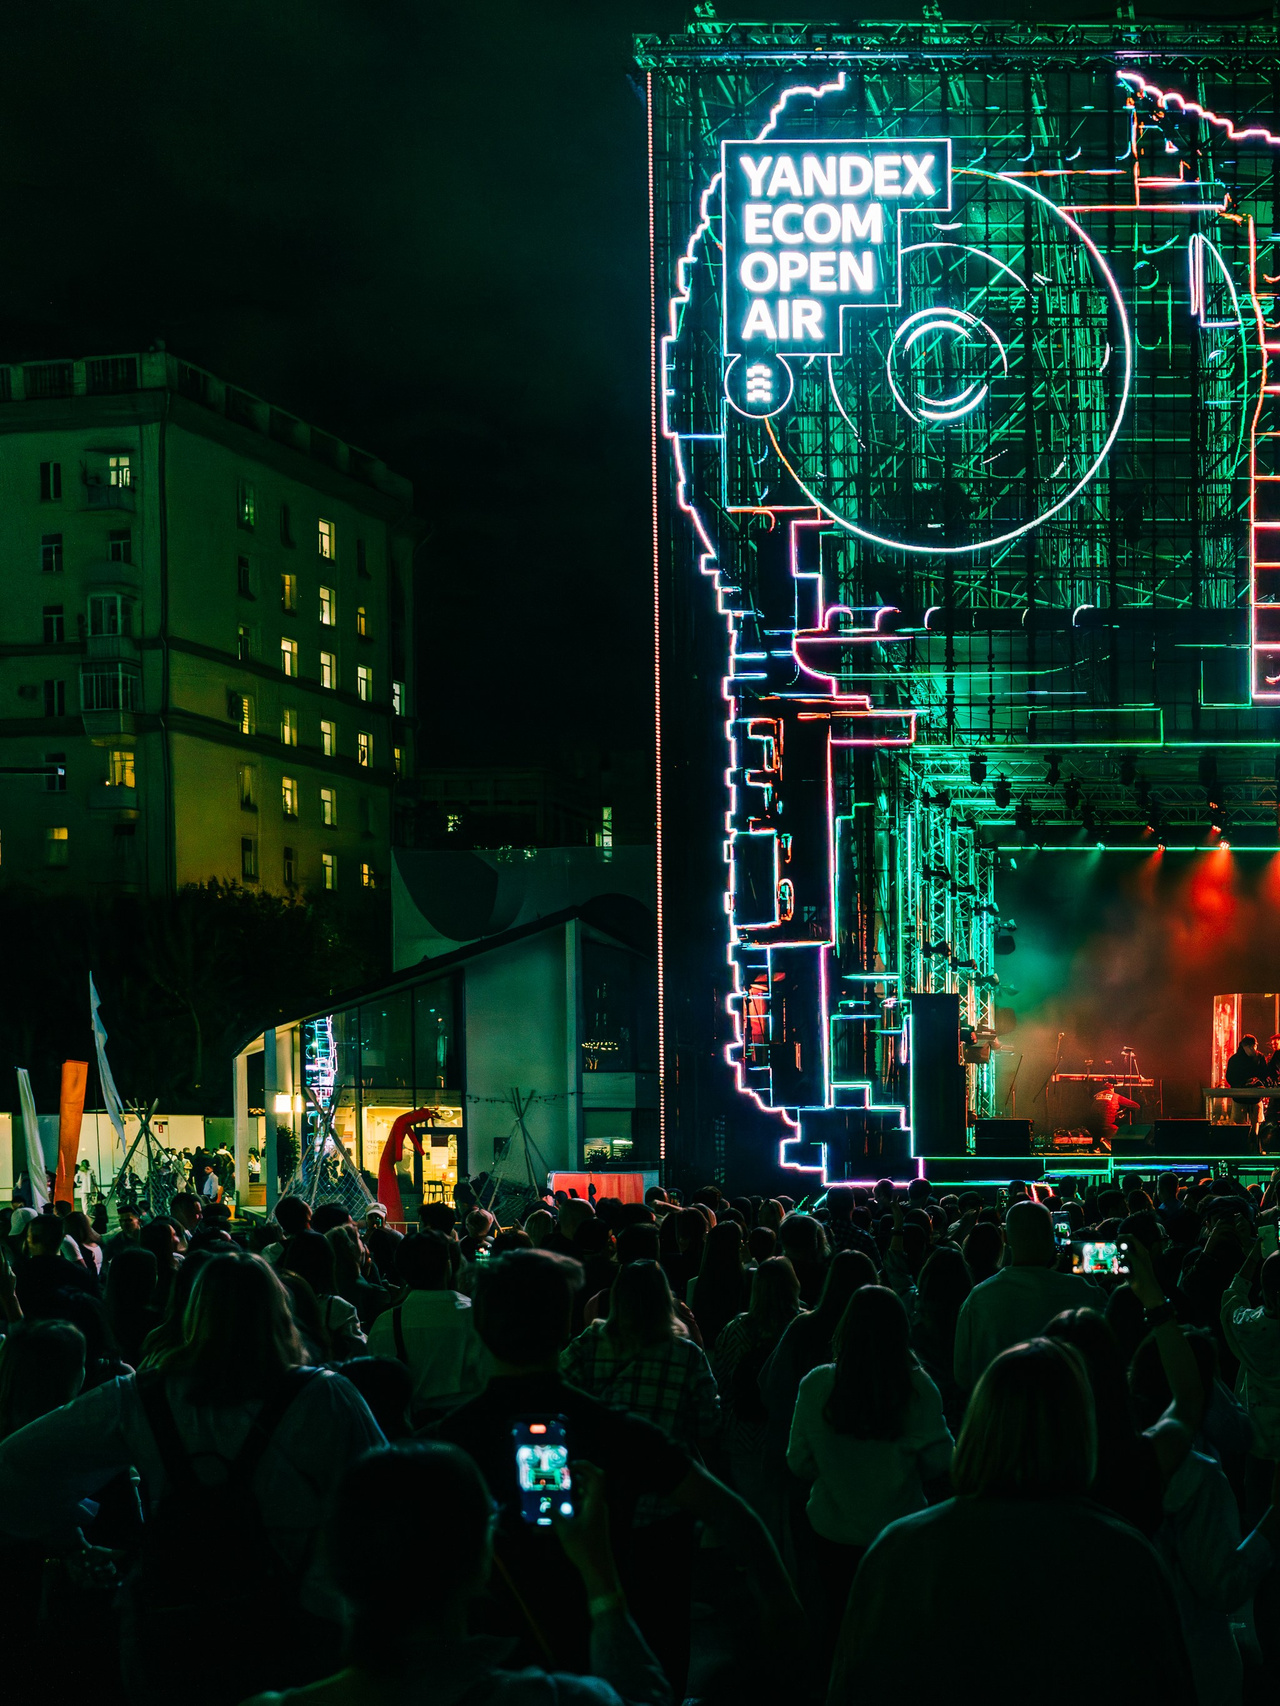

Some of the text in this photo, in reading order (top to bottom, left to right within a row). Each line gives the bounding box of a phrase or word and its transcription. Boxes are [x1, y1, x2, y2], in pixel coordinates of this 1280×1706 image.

[740, 154, 936, 197] YANDEX
[745, 203, 882, 244] ECOM
[740, 251, 874, 292] OPEN
[741, 299, 824, 340] AIR
